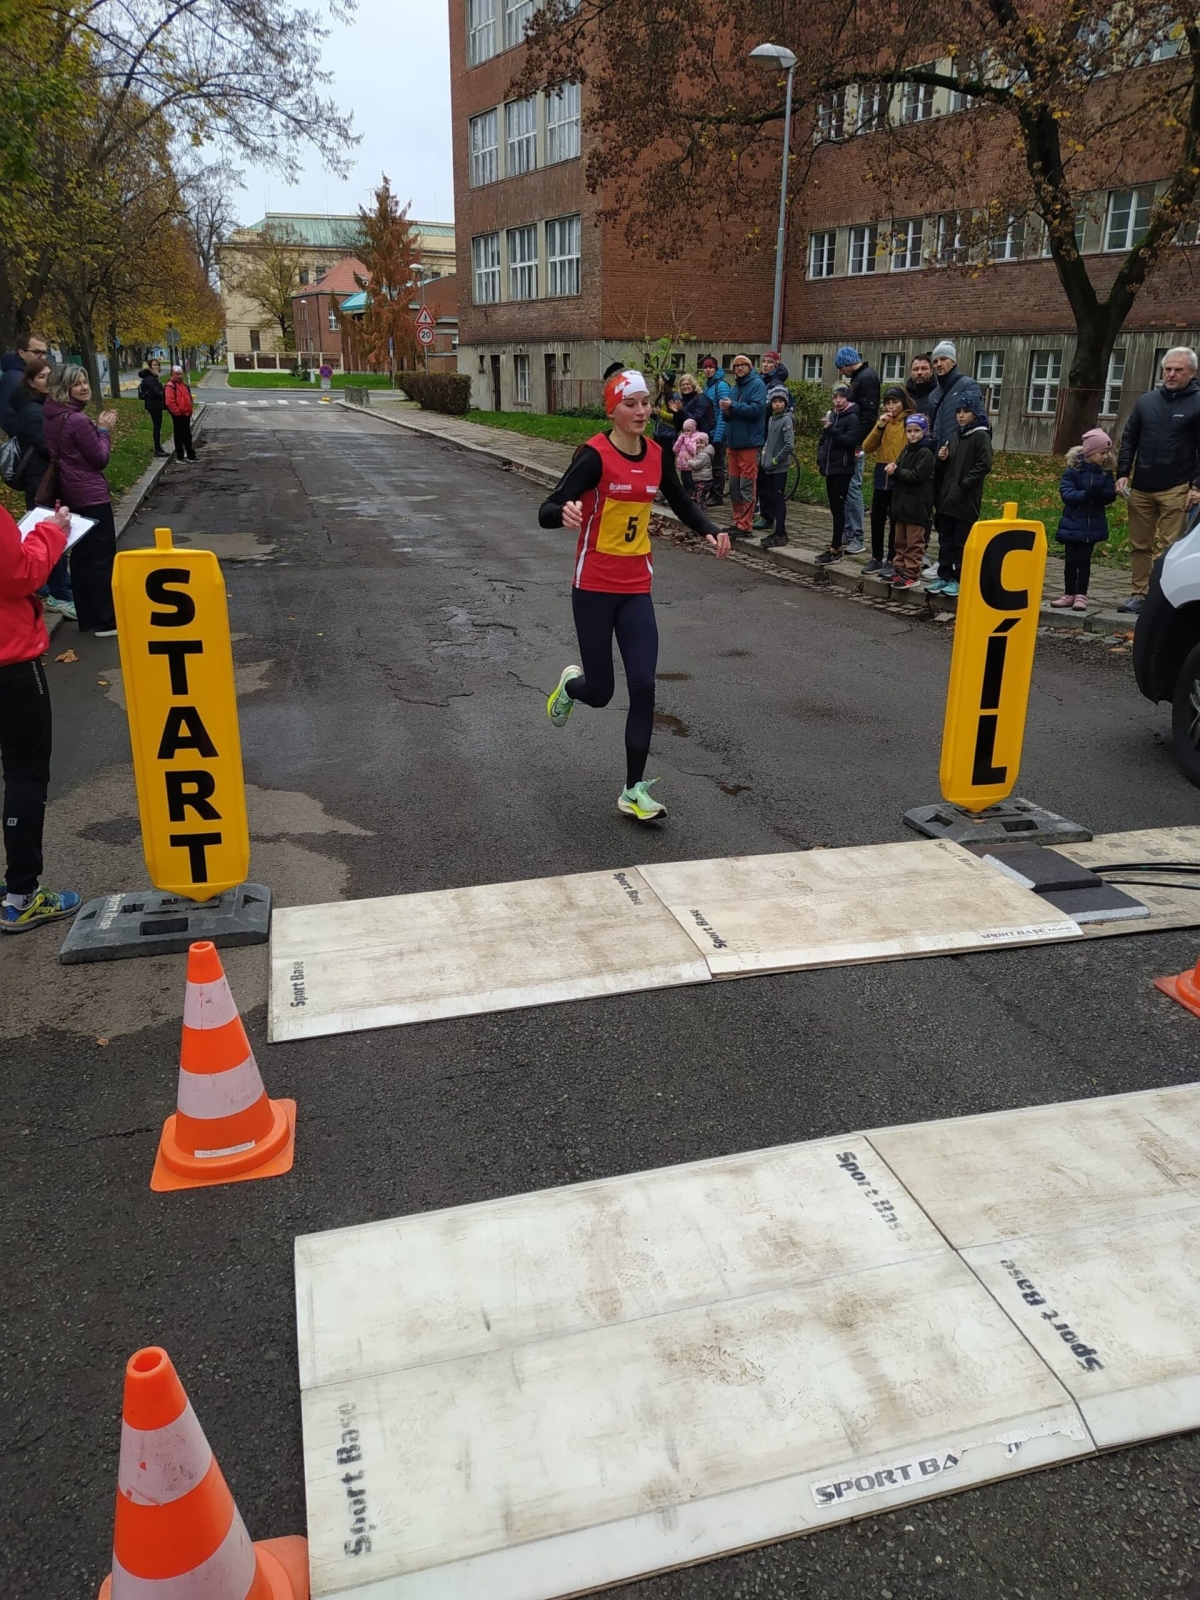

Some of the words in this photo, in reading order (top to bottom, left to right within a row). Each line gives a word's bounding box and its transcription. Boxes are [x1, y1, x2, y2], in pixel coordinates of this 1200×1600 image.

[421, 330, 431, 339] 20
[624, 516, 639, 543] 5
[971, 529, 1037, 786] CÍL
[145, 567, 223, 884] START
[613, 872, 633, 890] Sport
[703, 926, 728, 949] Sport
[979, 930, 1015, 939] SPORT
[289, 960, 305, 981] Base
[290, 981, 309, 1008] Sport
[835, 1151, 880, 1198] Sport
[1000, 1259, 1048, 1307] Base
[1040, 1309, 1106, 1373] Sport
[814, 1463, 913, 1504] SPORT
[919, 1449, 968, 1477] BA
[340, 1469, 378, 1557] Sport
